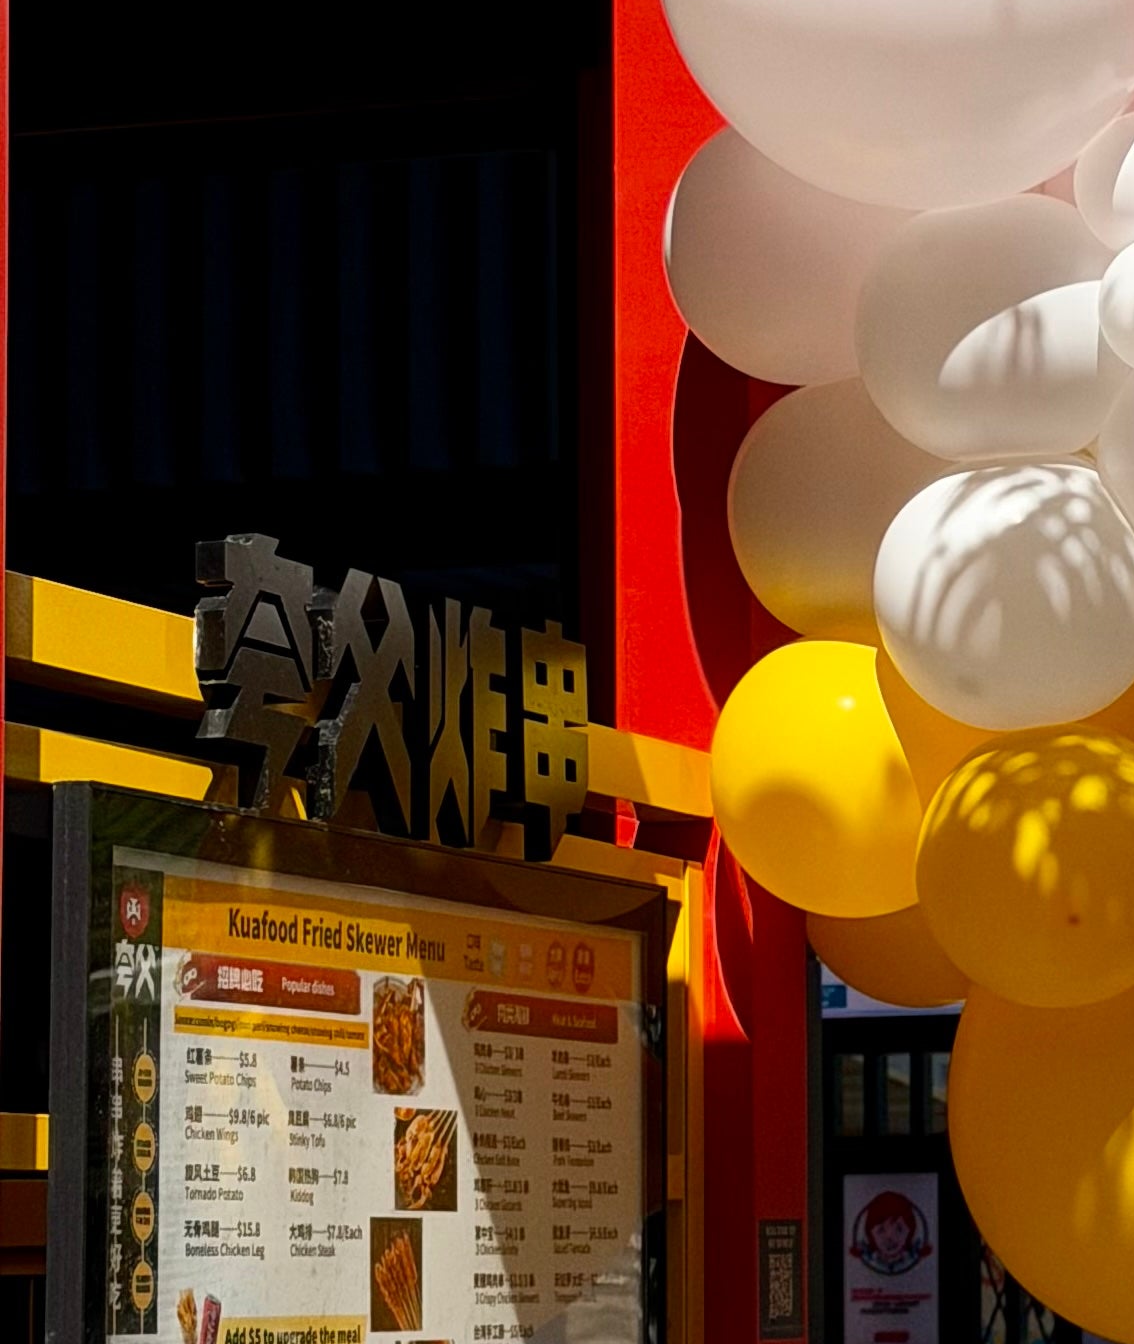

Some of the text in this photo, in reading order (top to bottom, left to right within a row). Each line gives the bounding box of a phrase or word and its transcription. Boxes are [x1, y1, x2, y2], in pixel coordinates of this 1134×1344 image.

[228, 908, 445, 962] Kuafood Fried Skewer Menu
[281, 976, 335, 997] Popular dishes
[239, 1050, 257, 1068] $5.8
[334, 1059, 350, 1077] $4.5
[185, 1070, 257, 1088] Sweet Potato Chips
[291, 1077, 332, 1095] Potato Chips
[229, 1109, 255, 1128] $9.8/6
[257, 1111, 270, 1129] pic
[346, 1115, 357, 1131] pic
[185, 1125, 239, 1145] Chicken Wings
[289, 1133, 326, 1150] Stinky Tofu
[237, 1166, 256, 1183] $6.8
[185, 1186, 244, 1202] Tornado Potato
[237, 1221, 261, 1238] $15.8
[185, 1243, 265, 1260] Boneless Chicken Leg
[290, 1244, 317, 1257] Chicken
[319, 1325, 335, 1344] the
[337, 1324, 362, 1344] meal
